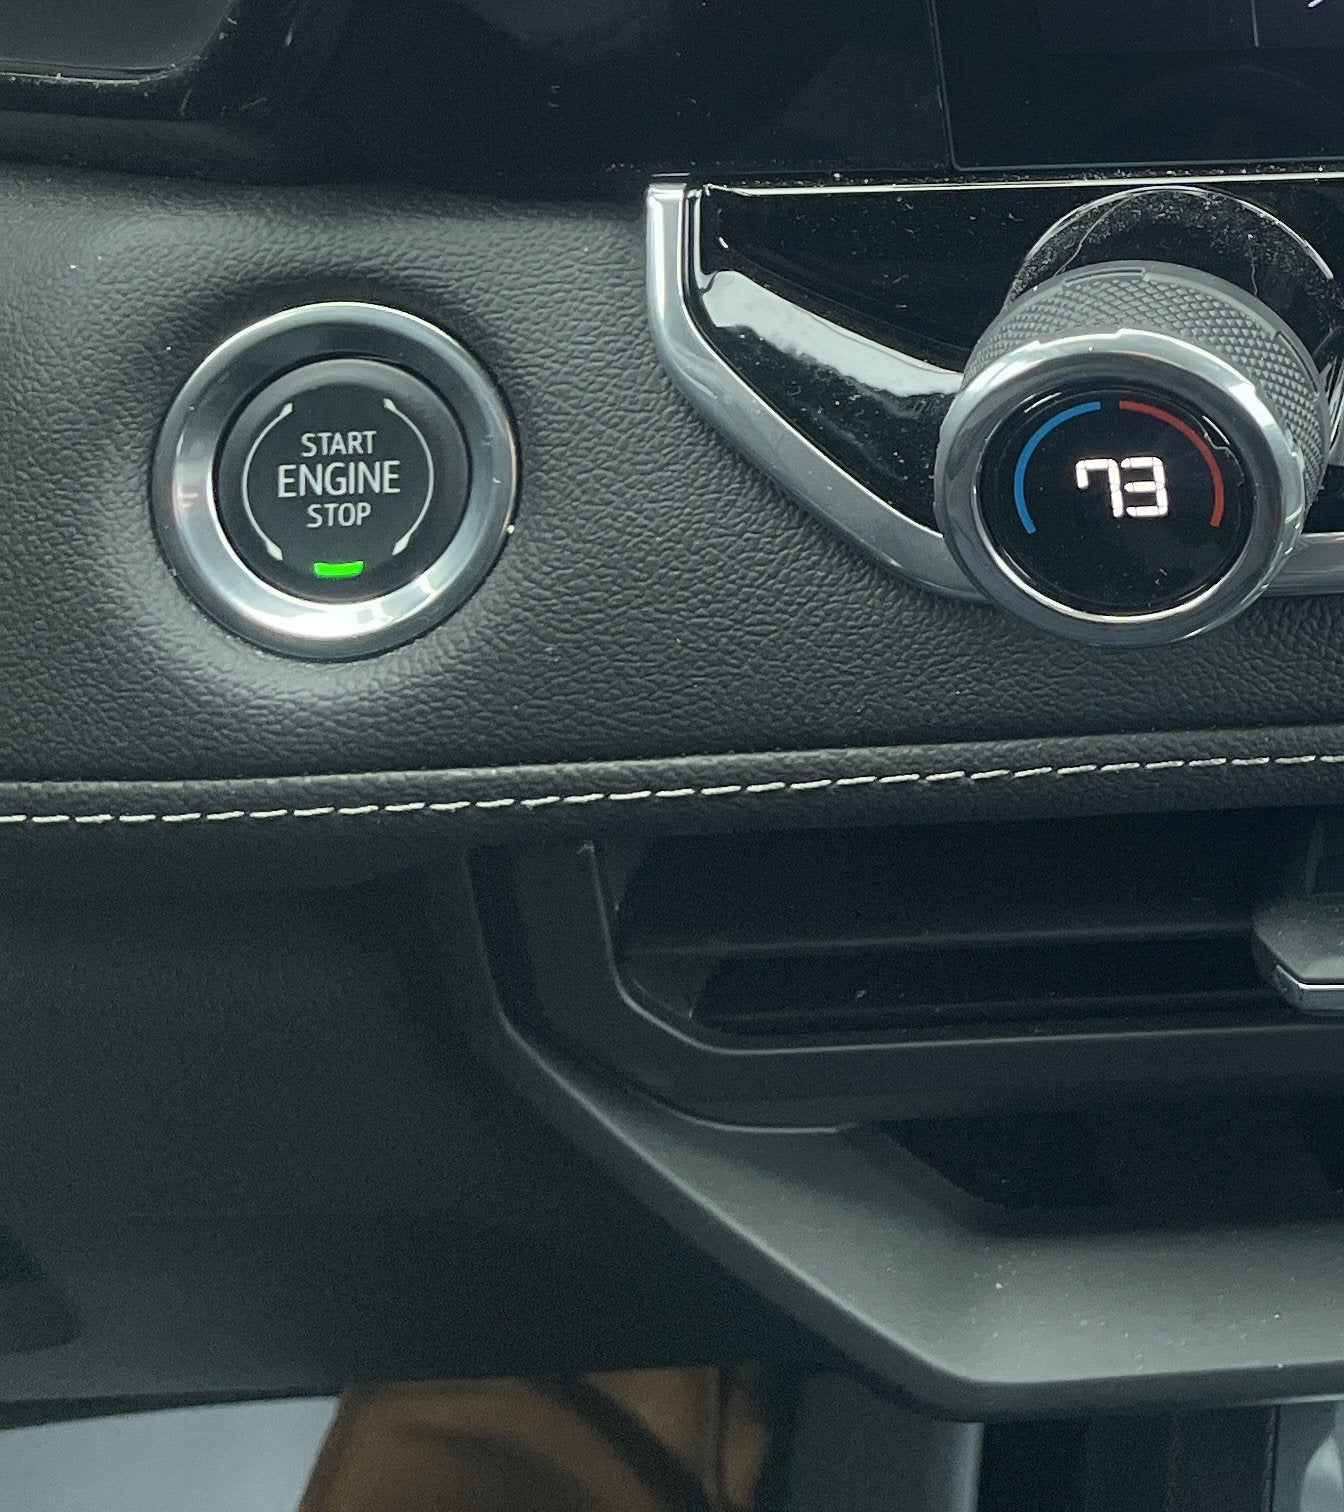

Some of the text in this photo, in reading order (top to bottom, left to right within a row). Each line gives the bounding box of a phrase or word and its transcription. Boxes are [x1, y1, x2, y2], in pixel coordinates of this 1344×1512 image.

[301, 430, 378, 457] START
[278, 459, 401, 498] ENGINE
[1074, 455, 1170, 519] 73
[306, 501, 372, 528] STOP
